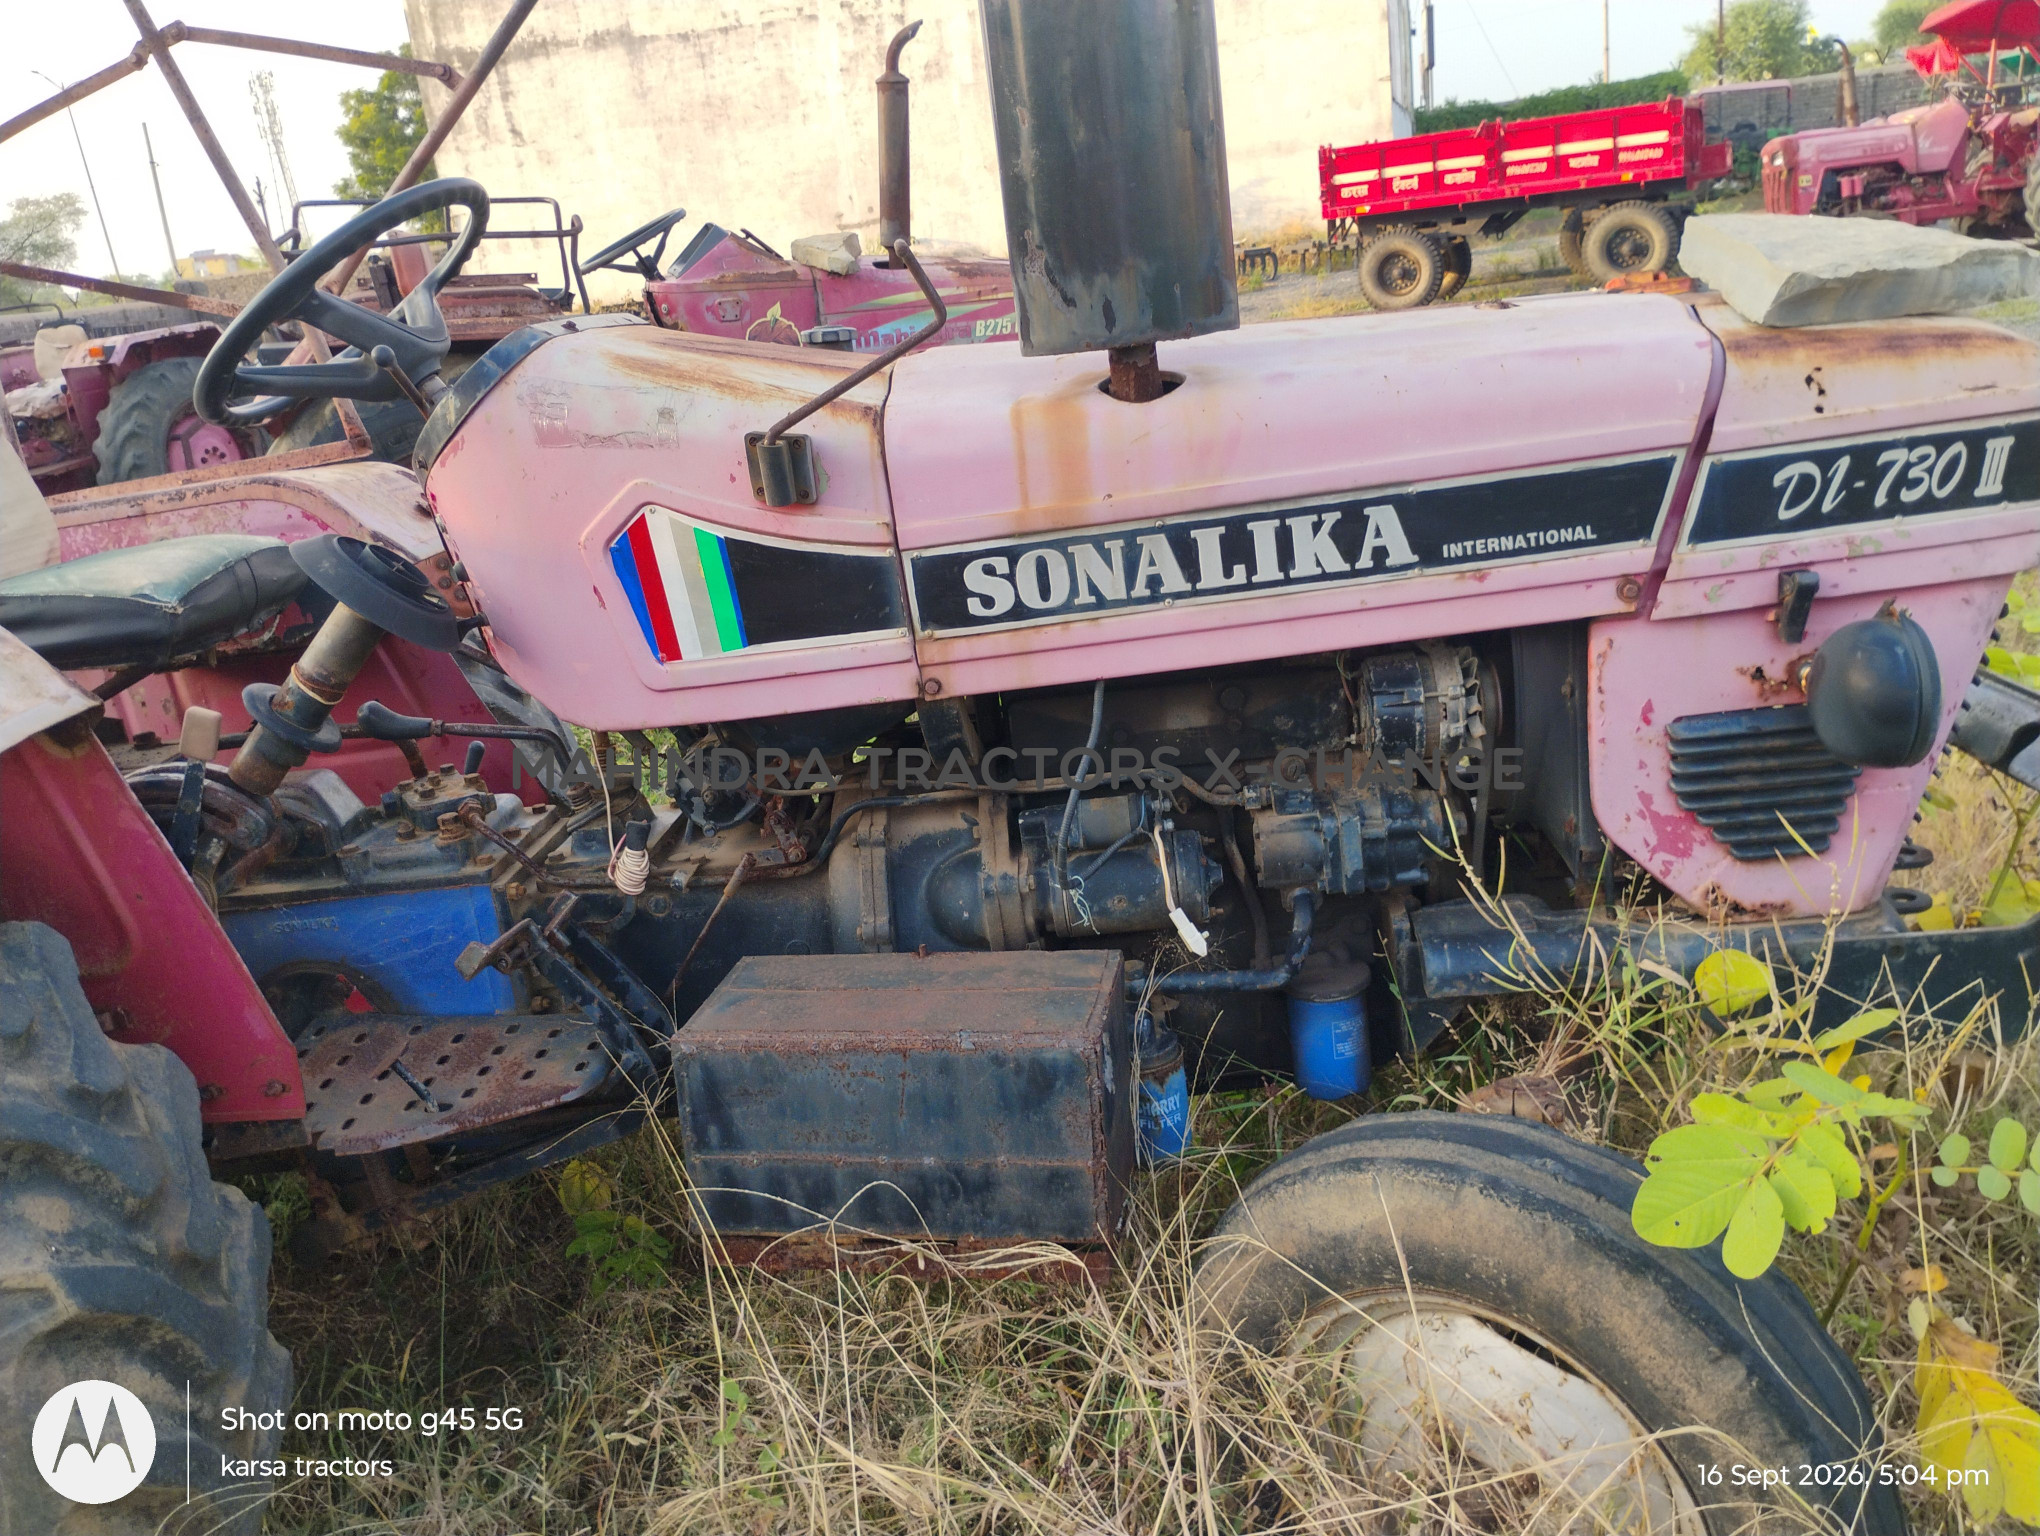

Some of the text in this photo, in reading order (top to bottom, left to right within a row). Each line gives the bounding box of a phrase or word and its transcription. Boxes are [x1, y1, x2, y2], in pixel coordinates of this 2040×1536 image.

[975, 317, 1012, 338] B275
[962, 503, 1598, 618] SONALIKA INTERNATIONAL
[1140, 1112, 1182, 1130] FILTER
